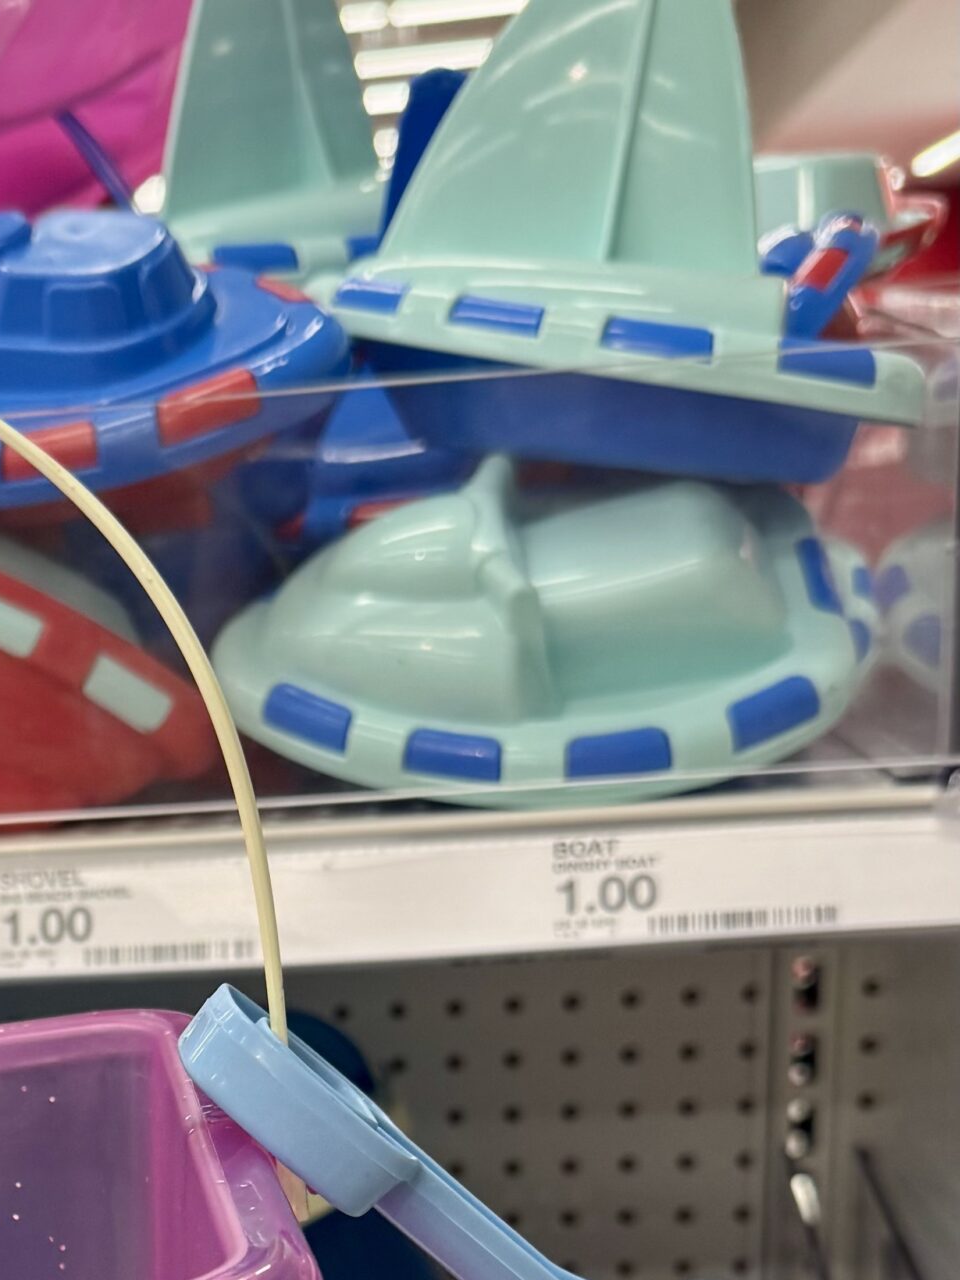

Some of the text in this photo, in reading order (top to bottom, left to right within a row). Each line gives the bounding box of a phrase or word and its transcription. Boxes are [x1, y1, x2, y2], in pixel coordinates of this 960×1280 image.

[552, 839, 620, 859] BOAT
[555, 873, 657, 915] 1.00
[0, 906, 92, 945] 1.00
